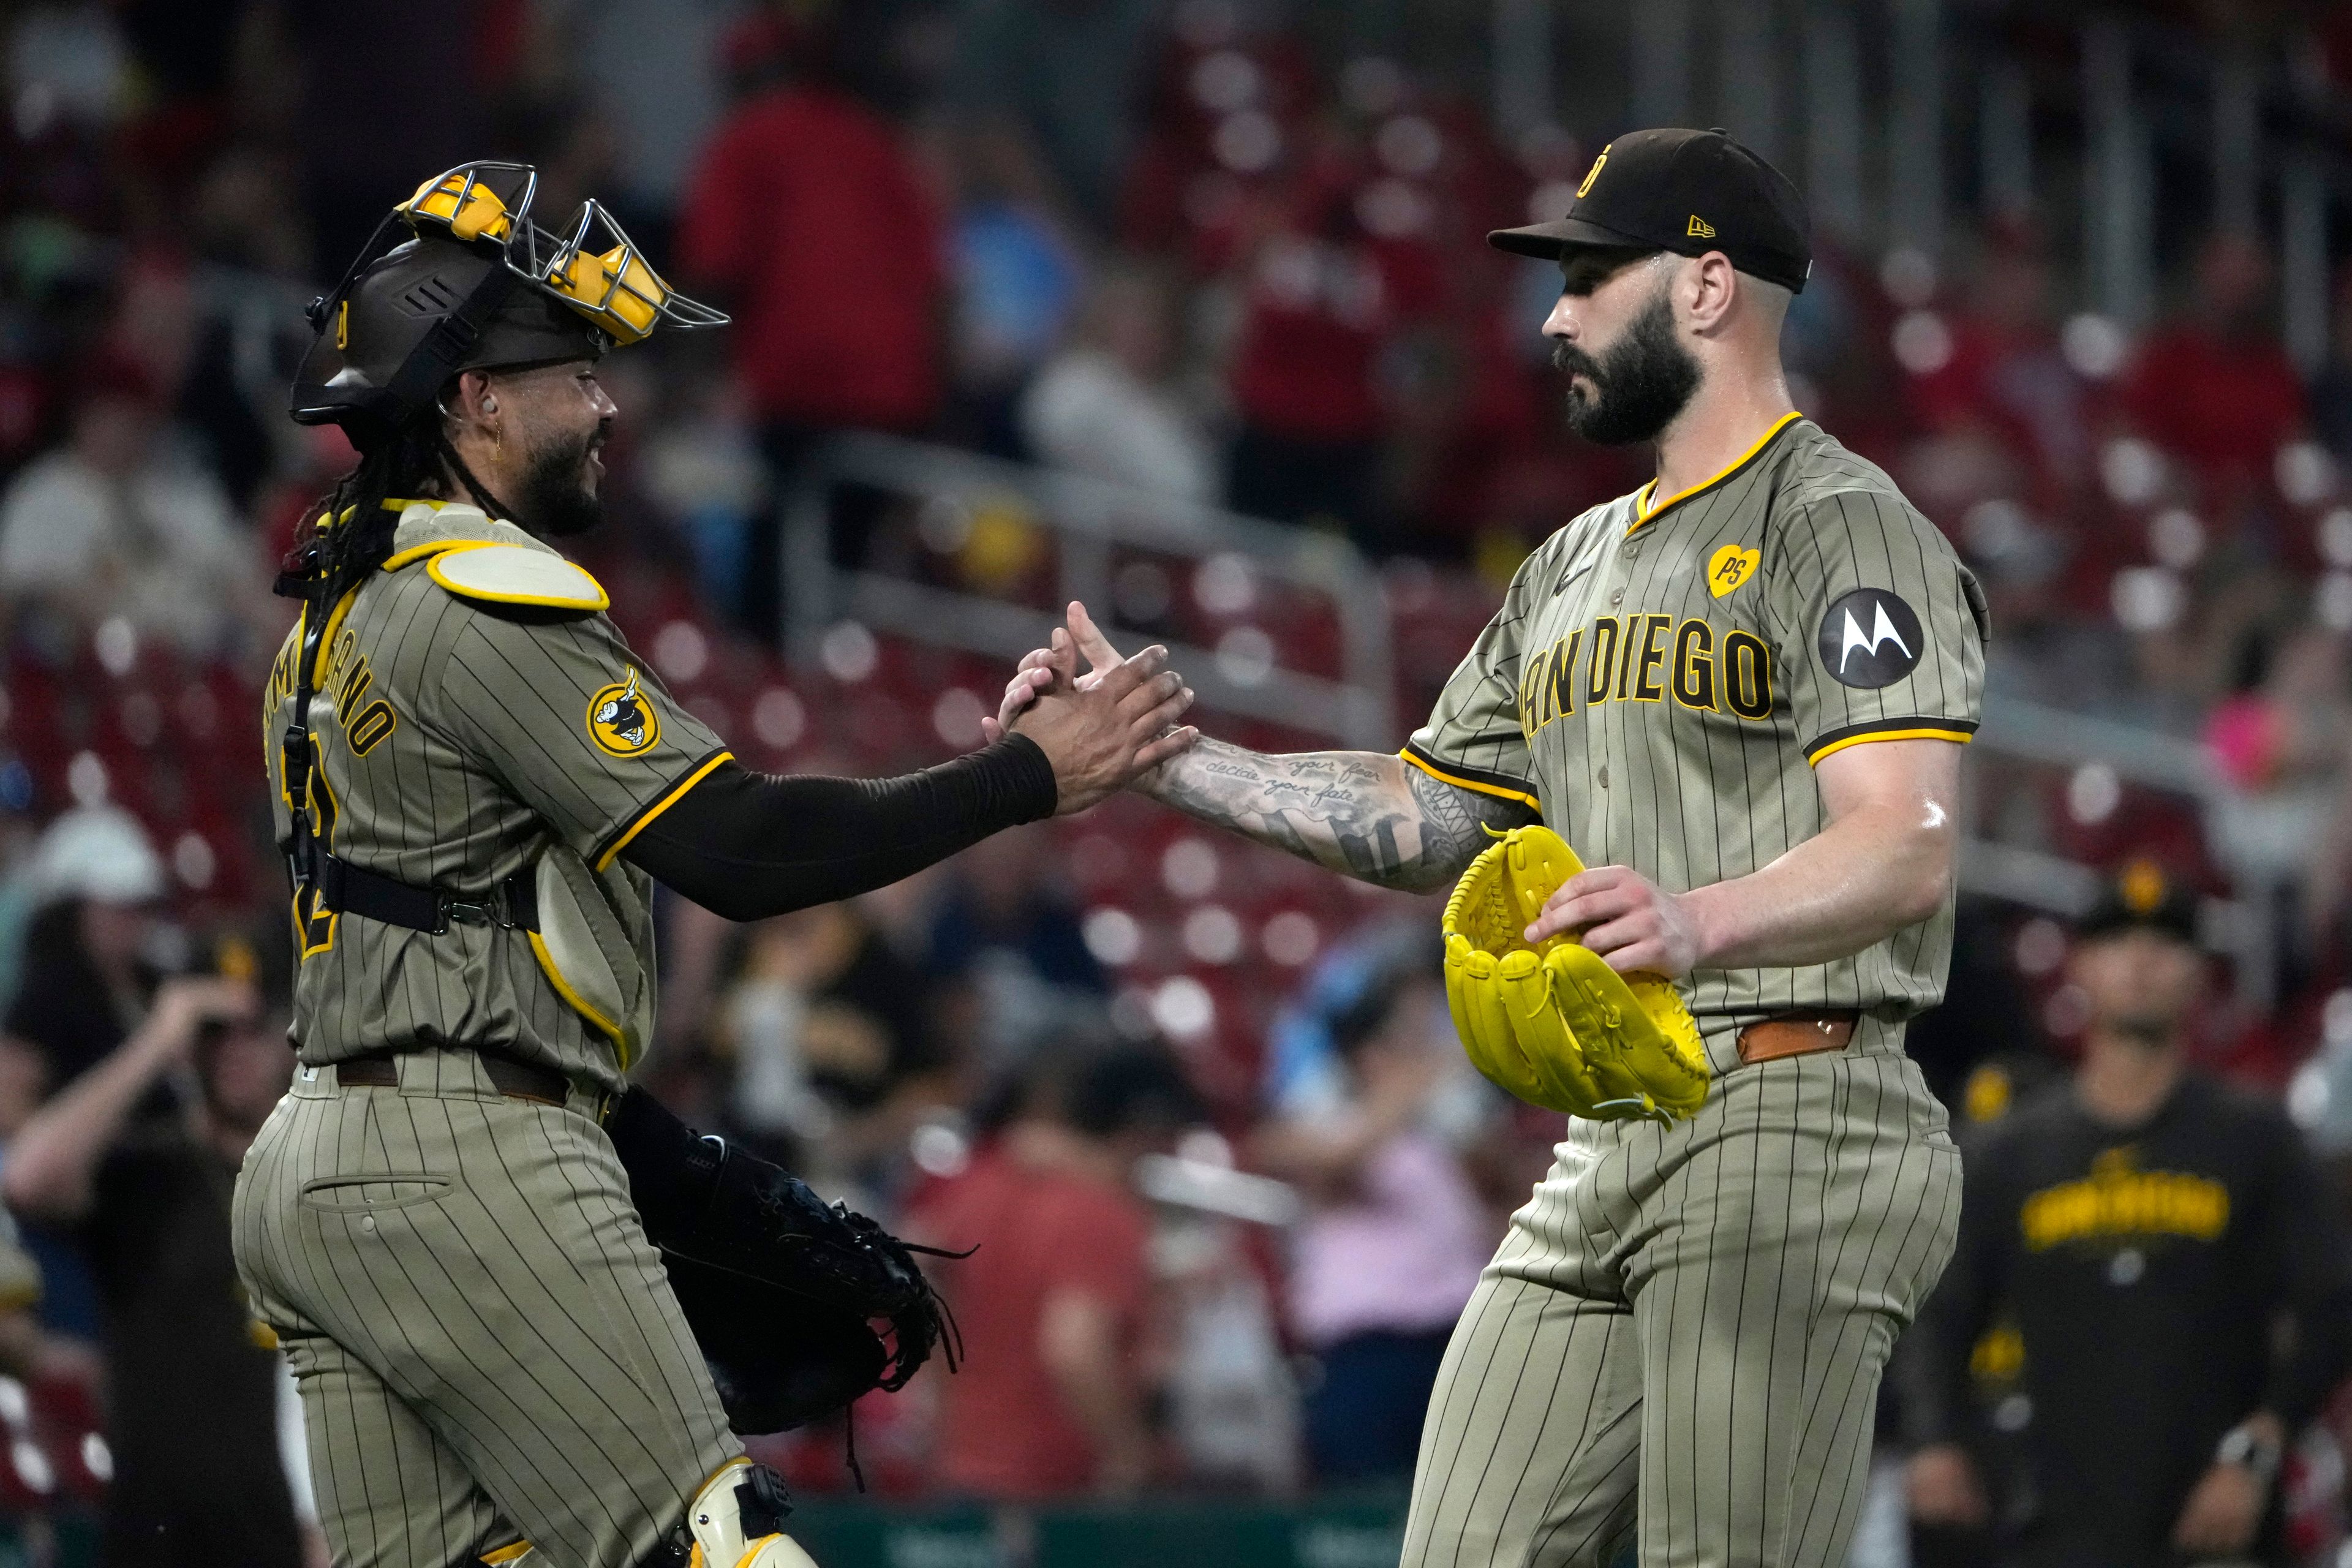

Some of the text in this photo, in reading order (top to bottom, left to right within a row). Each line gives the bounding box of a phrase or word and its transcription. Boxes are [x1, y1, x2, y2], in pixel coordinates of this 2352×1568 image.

[1715, 557, 1747, 585] PS
[1520, 612, 1773, 751] AN DIEGO
[1206, 761, 1352, 808] decide your fate
[1338, 763, 1381, 784] fear
